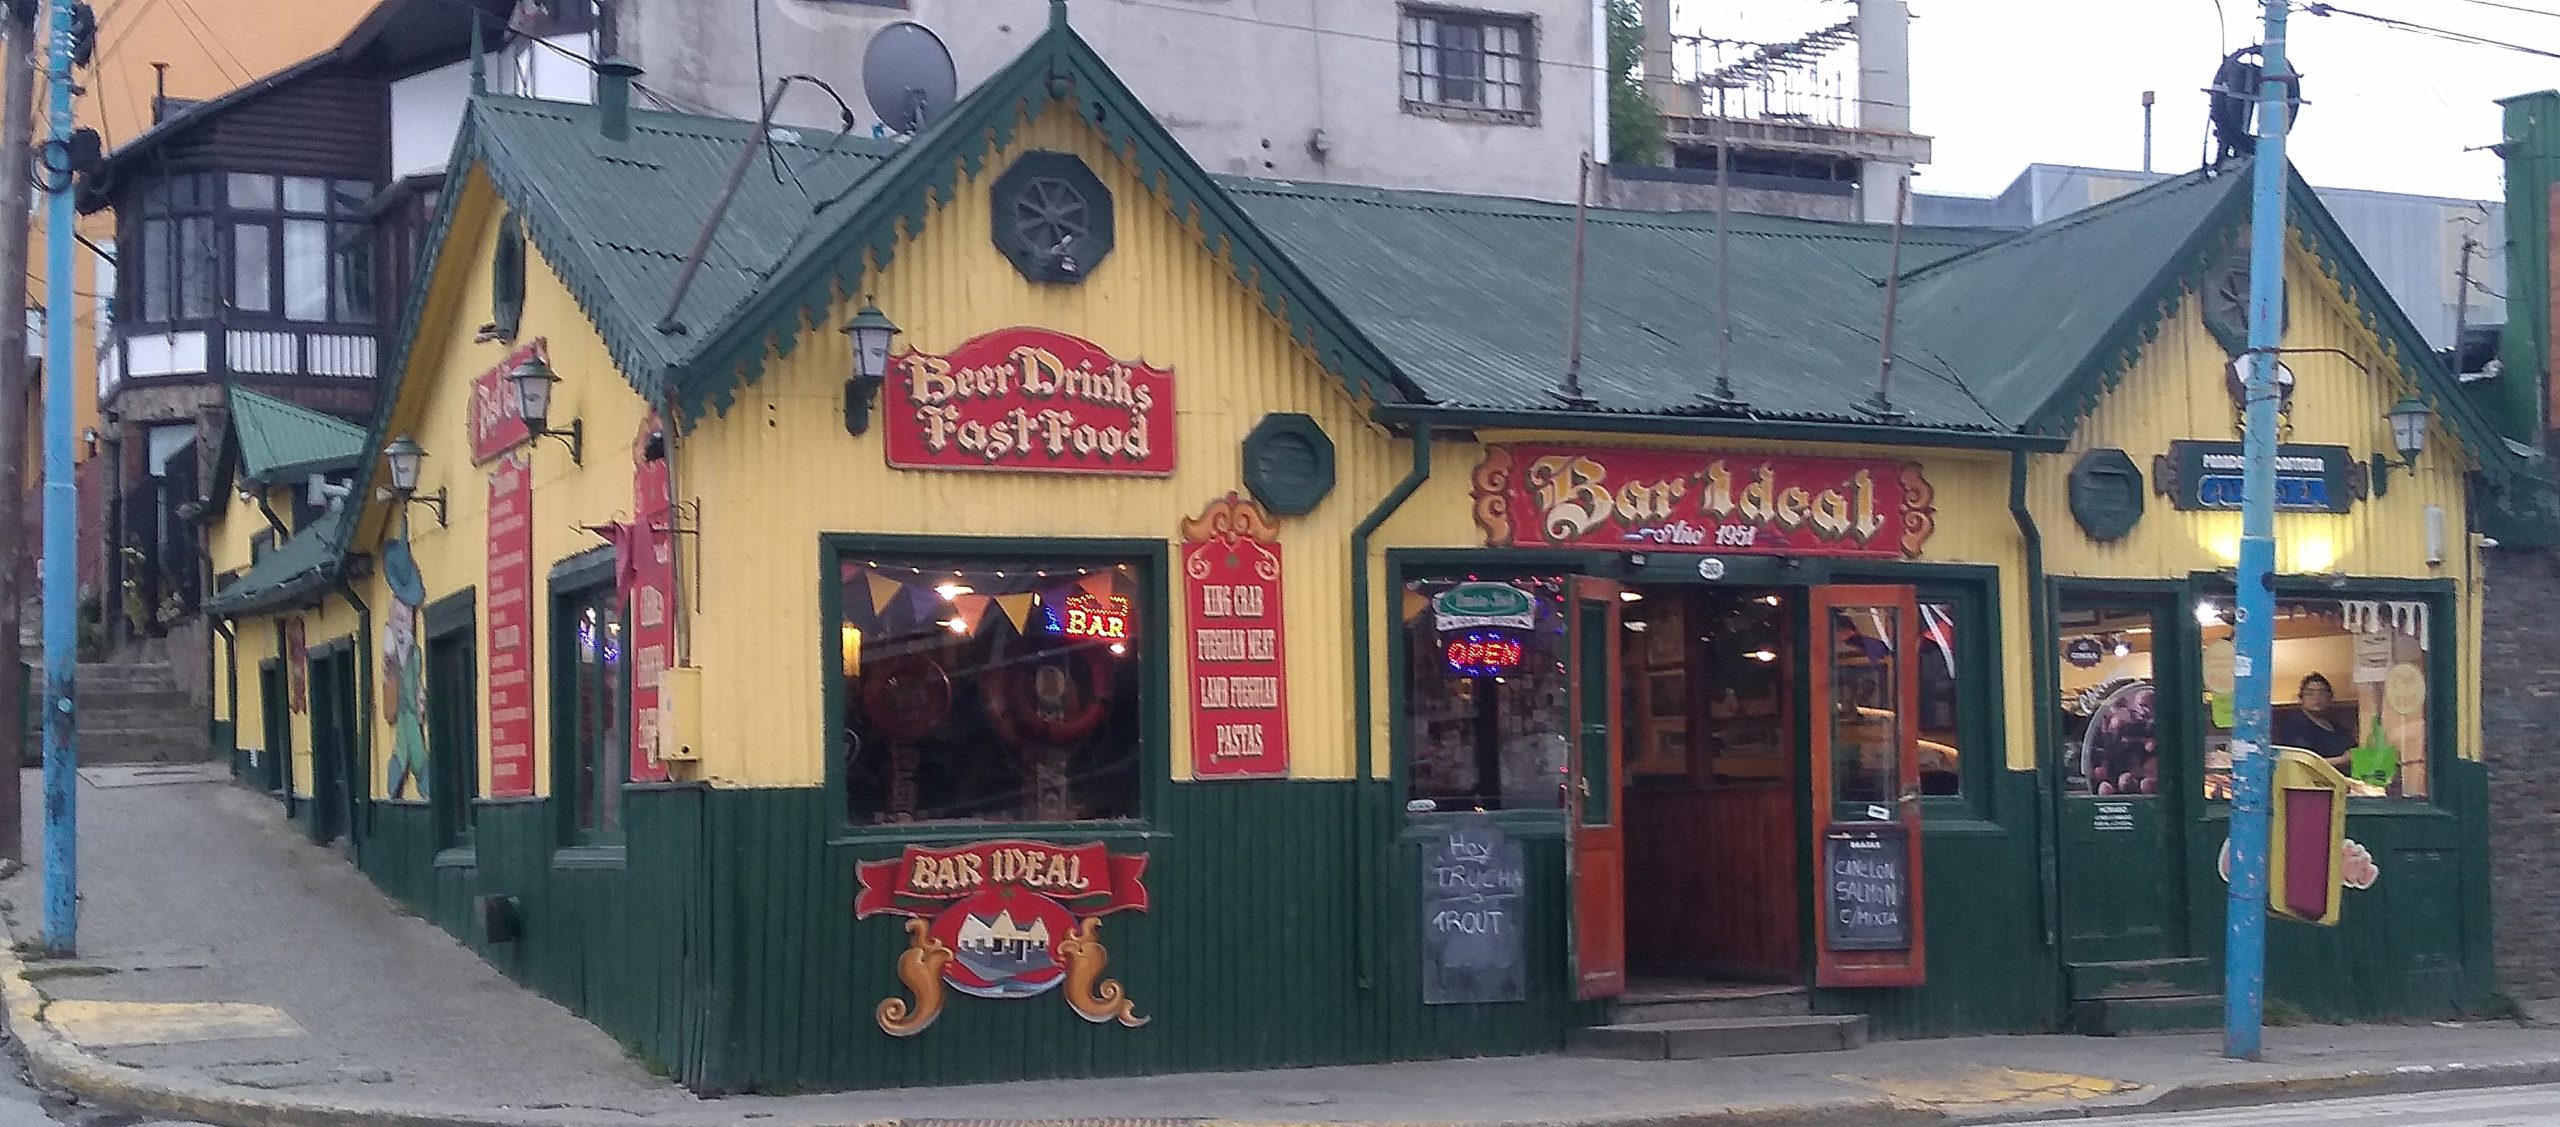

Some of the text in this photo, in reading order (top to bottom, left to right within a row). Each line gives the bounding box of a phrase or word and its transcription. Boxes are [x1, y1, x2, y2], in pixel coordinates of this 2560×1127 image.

[898, 345, 1153, 413] Beer Drinks
[916, 403, 1151, 460] Fast Food
[1526, 454, 1886, 542] Bar Ideal
[1715, 523, 1759, 547] 1951
[1203, 585, 1264, 617] KING CRAB
[1066, 609, 1125, 638] BAR
[1247, 629, 1276, 661] MEAT
[1448, 642, 1521, 666] OPEN
[1200, 677, 1229, 708] LAMB
[1216, 724, 1264, 757] PASTAS
[911, 847, 1089, 890] BAR IDEAL
[1435, 865, 1523, 889] TRUCHA
[1432, 909, 1504, 935] TROUT
